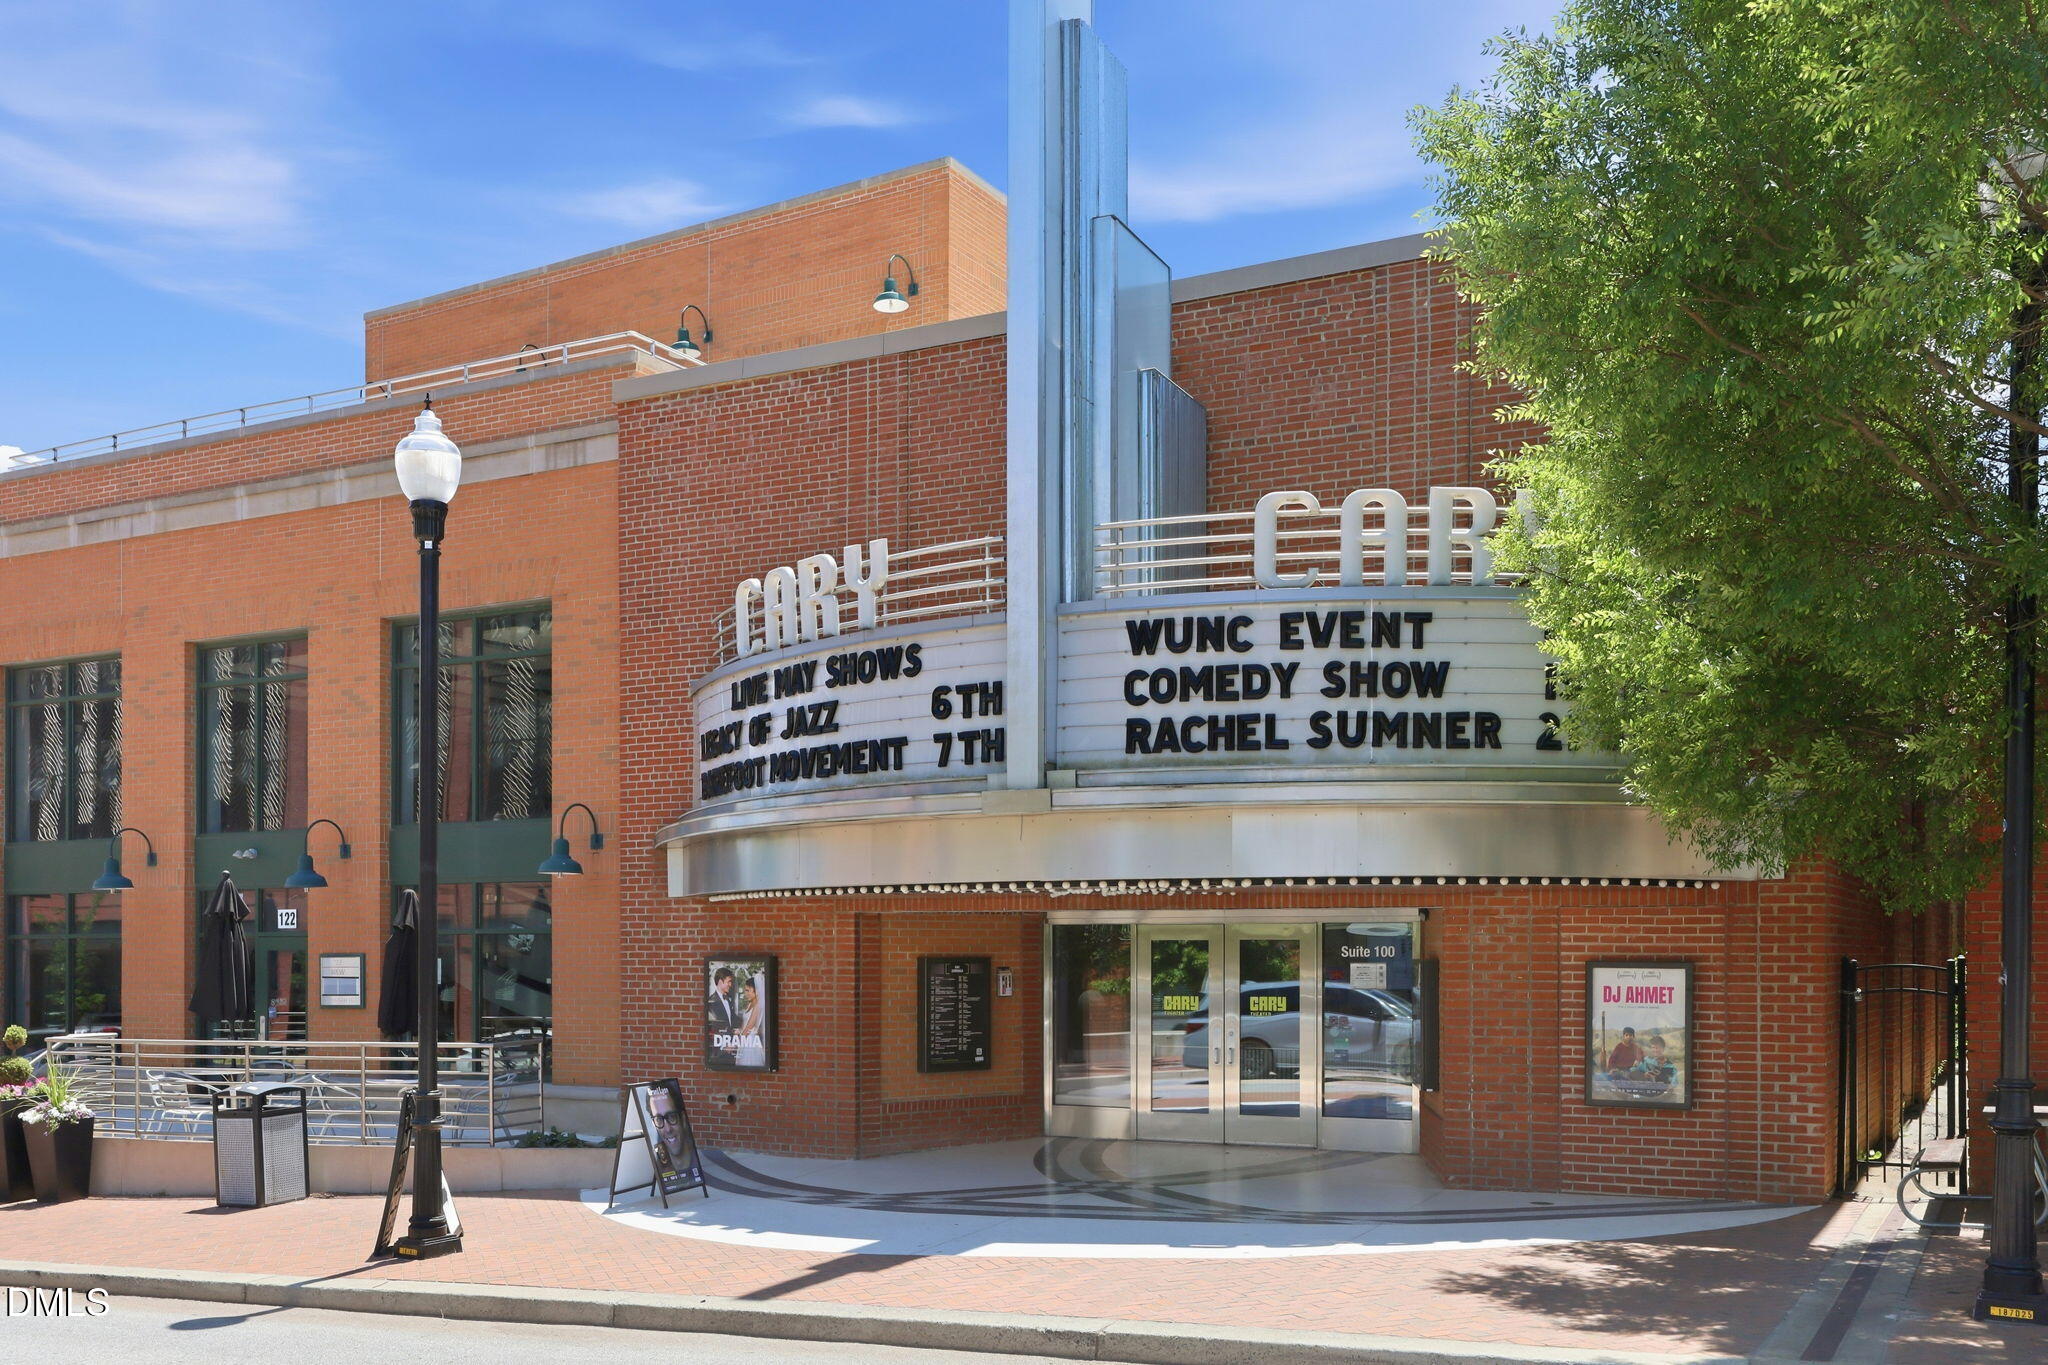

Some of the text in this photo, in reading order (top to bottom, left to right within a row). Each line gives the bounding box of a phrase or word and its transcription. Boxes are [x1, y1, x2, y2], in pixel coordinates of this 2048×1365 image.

[736, 538, 888, 659] CARY
[1125, 611, 1433, 656] WUNC EVENT
[731, 643, 922, 711] LIVE MAY SHOWS
[1124, 660, 1450, 706] COMEDY SHOW
[749, 712, 772, 747] OF
[780, 700, 839, 740] JAZZ
[931, 680, 1003, 720] 6TH
[1125, 713, 1290, 754] RACHEL
[1306, 710, 1502, 750] SUMNER
[769, 736, 909, 783] MOVEMENT
[933, 727, 1005, 768] 7TH
[279, 911, 296, 926] 122
[1341, 945, 1396, 958] Suite 100
[1163, 995, 1199, 1011] CARY
[1249, 996, 1287, 1011] CARY
[1603, 985, 1675, 1004] DJ AHMET
[713, 1033, 763, 1049] DRAMA
